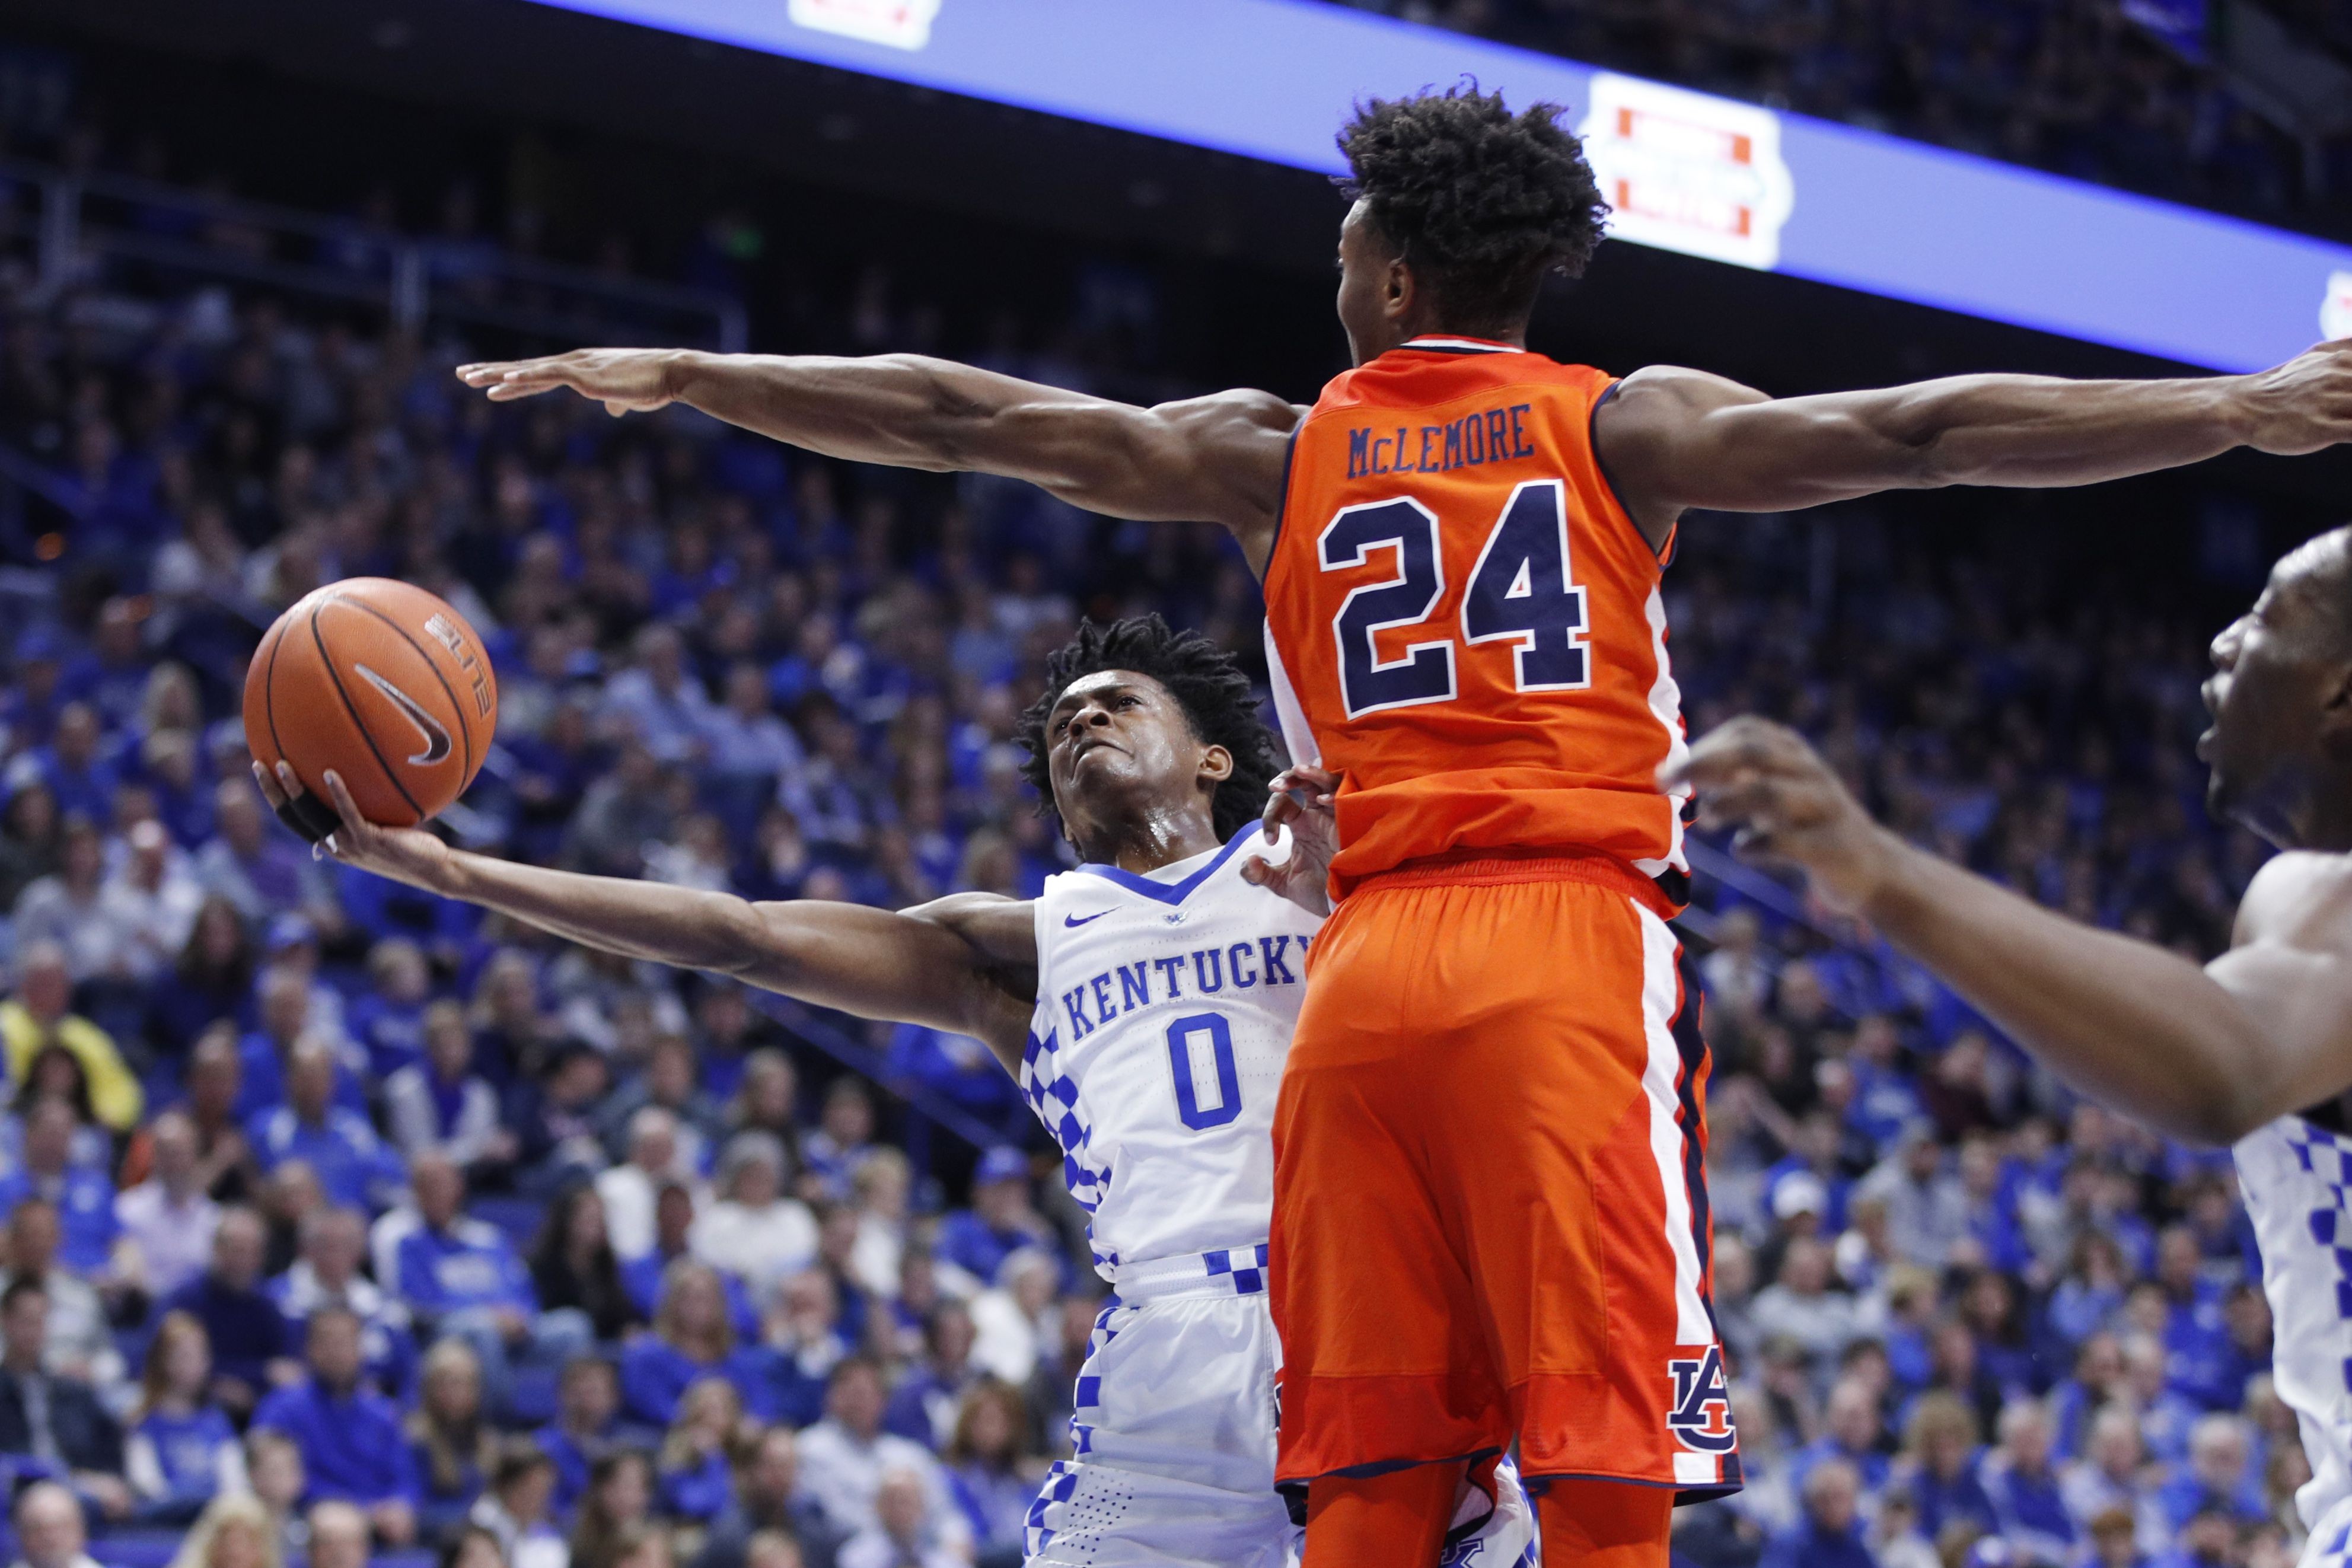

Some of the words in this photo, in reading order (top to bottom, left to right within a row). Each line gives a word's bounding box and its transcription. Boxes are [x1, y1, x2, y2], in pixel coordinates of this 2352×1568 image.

[1317, 478, 1591, 721] 24
[423, 612, 492, 721] ELITE
[1061, 934, 1315, 1044] KENTUCK
[1165, 1011, 1244, 1132] 0
